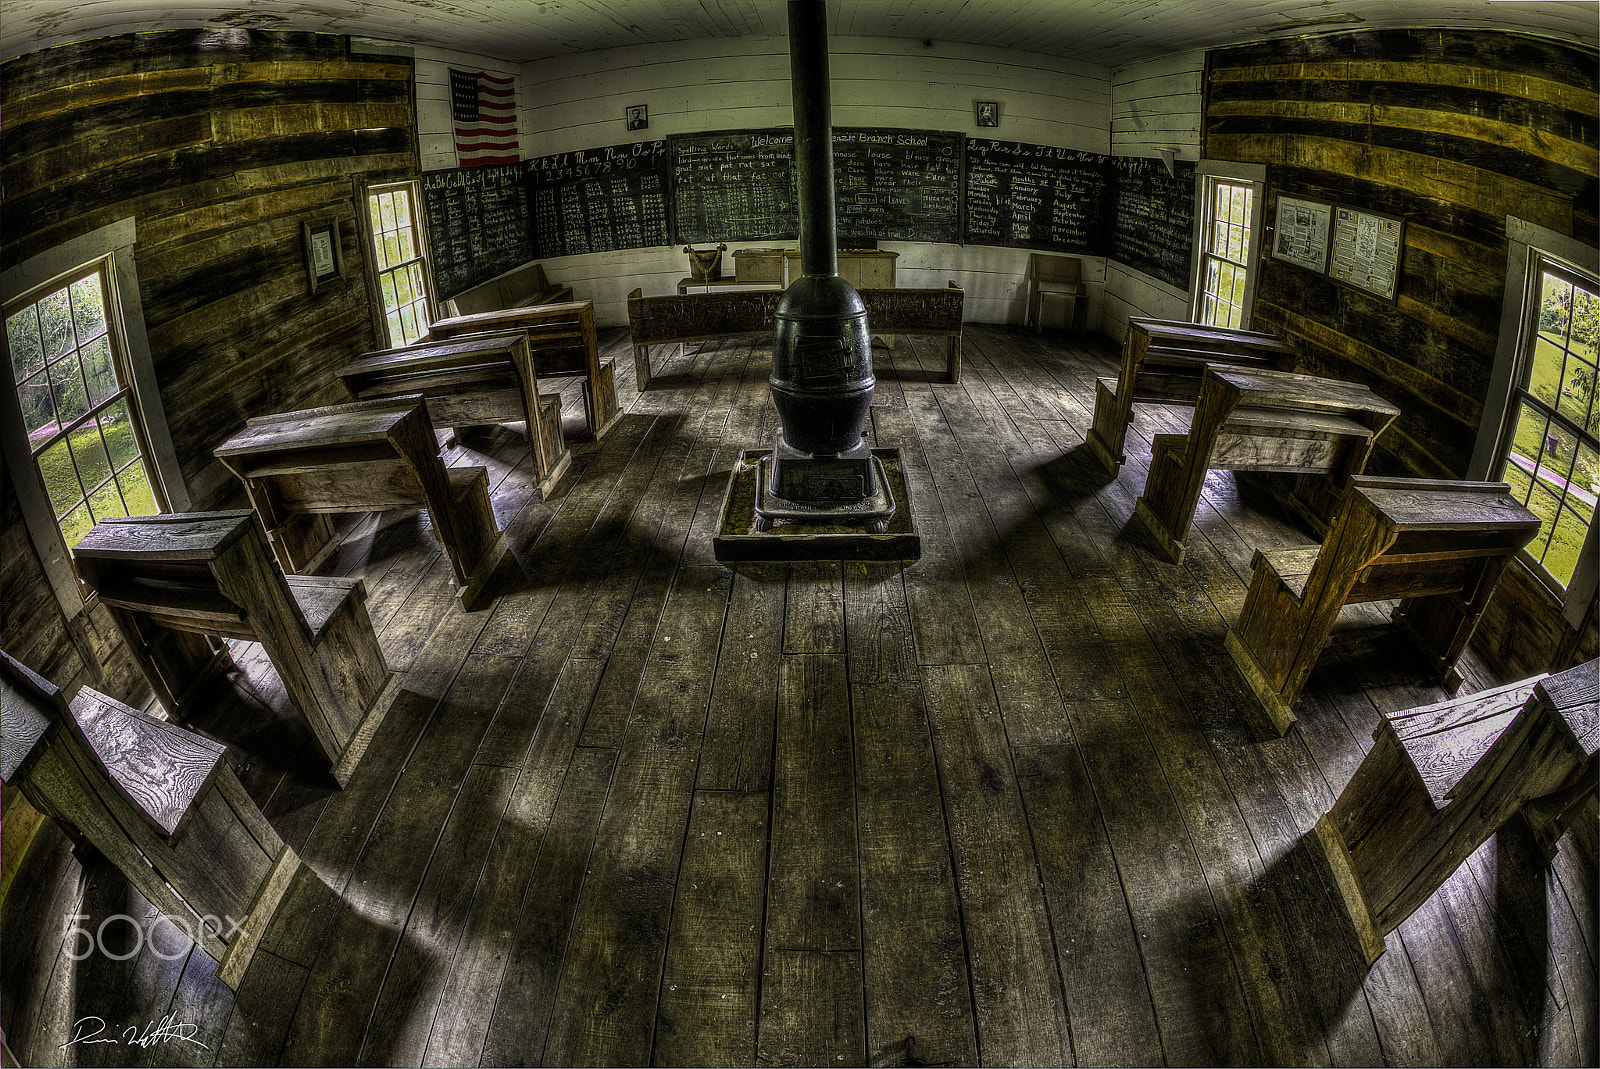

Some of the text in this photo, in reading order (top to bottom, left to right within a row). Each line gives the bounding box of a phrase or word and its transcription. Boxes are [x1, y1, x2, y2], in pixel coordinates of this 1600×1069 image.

[751, 134, 793, 149] Welcome
[858, 132, 893, 145] Branch
[894, 134, 928, 147] School
[678, 143, 736, 156] Spelling Words
[867, 148, 893, 159] louse
[905, 150, 930, 162] blouse
[758, 152, 775, 160] from
[575, 165, 582, 177] 5
[602, 161, 611, 173] 8
[720, 162, 734, 172] pat
[873, 159, 892, 168] hare
[901, 160, 920, 170] hair
[722, 172, 742, 182] that
[751, 172, 768, 182] fat
[925, 172, 946, 182] fare
[1010, 184, 1038, 195] January
[1012, 176, 1036, 184] Months
[1070, 183, 1085, 193] Year
[967, 190, 990, 200] Monday
[1011, 192, 1042, 205] February
[1054, 189, 1072, 200] July
[968, 197, 992, 206] Tuesday
[1011, 202, 1036, 212] March
[1053, 199, 1077, 210] August
[969, 210, 996, 222] Thursday
[1012, 211, 1031, 221] April
[1053, 208, 1087, 219] September
[1052, 216, 1081, 226] October
[968, 225, 1001, 237] Saturday
[1012, 223, 1029, 232] May
[1051, 225, 1087, 236] November
[1012, 231, 1030, 239] June
[1052, 234, 1088, 246] December
